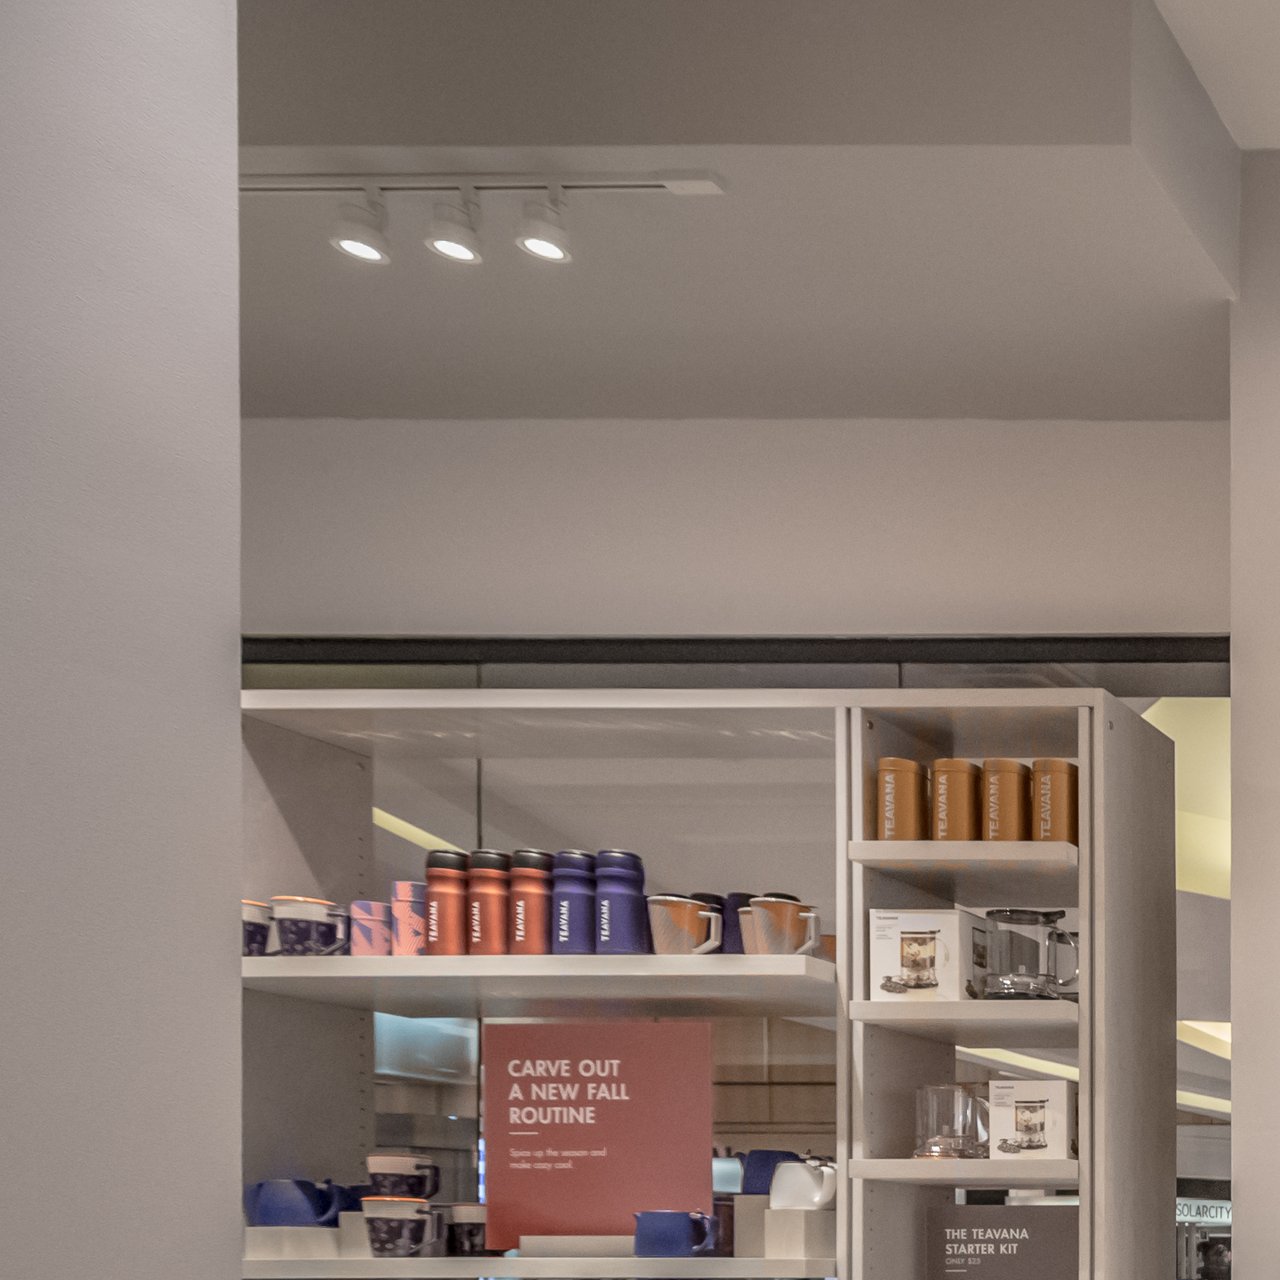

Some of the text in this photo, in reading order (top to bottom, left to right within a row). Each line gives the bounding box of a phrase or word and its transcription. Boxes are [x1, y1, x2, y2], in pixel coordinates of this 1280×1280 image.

[885, 773, 895, 839] TEAVANA
[938, 774, 949, 839] TEAVANA
[989, 774, 1000, 839] TEAVANA
[1041, 774, 1051, 839] TEAVANA
[428, 901, 438, 942] TEAVANA
[472, 902, 480, 943] TEAVANA
[515, 899, 525, 942] TEAVANA
[559, 901, 569, 942] TEAVANA
[600, 899, 610, 941] TEAVANA
[508, 1059, 621, 1077] CARVE OUT
[508, 1083, 629, 1100] A NEW FALL
[509, 1107, 595, 1124] ROUTINE
[510, 1148, 531, 1158] Spice
[533, 1150, 544, 1159] up
[546, 1147, 559, 1157] the
[590, 1147, 607, 1157] and
[1176, 1203, 1231, 1219] SOLARCITY
[945, 1228, 1029, 1239] THE TEAVANA
[945, 1243, 1018, 1254] STARTER KIT
[945, 1257, 965, 1265] ONLY
